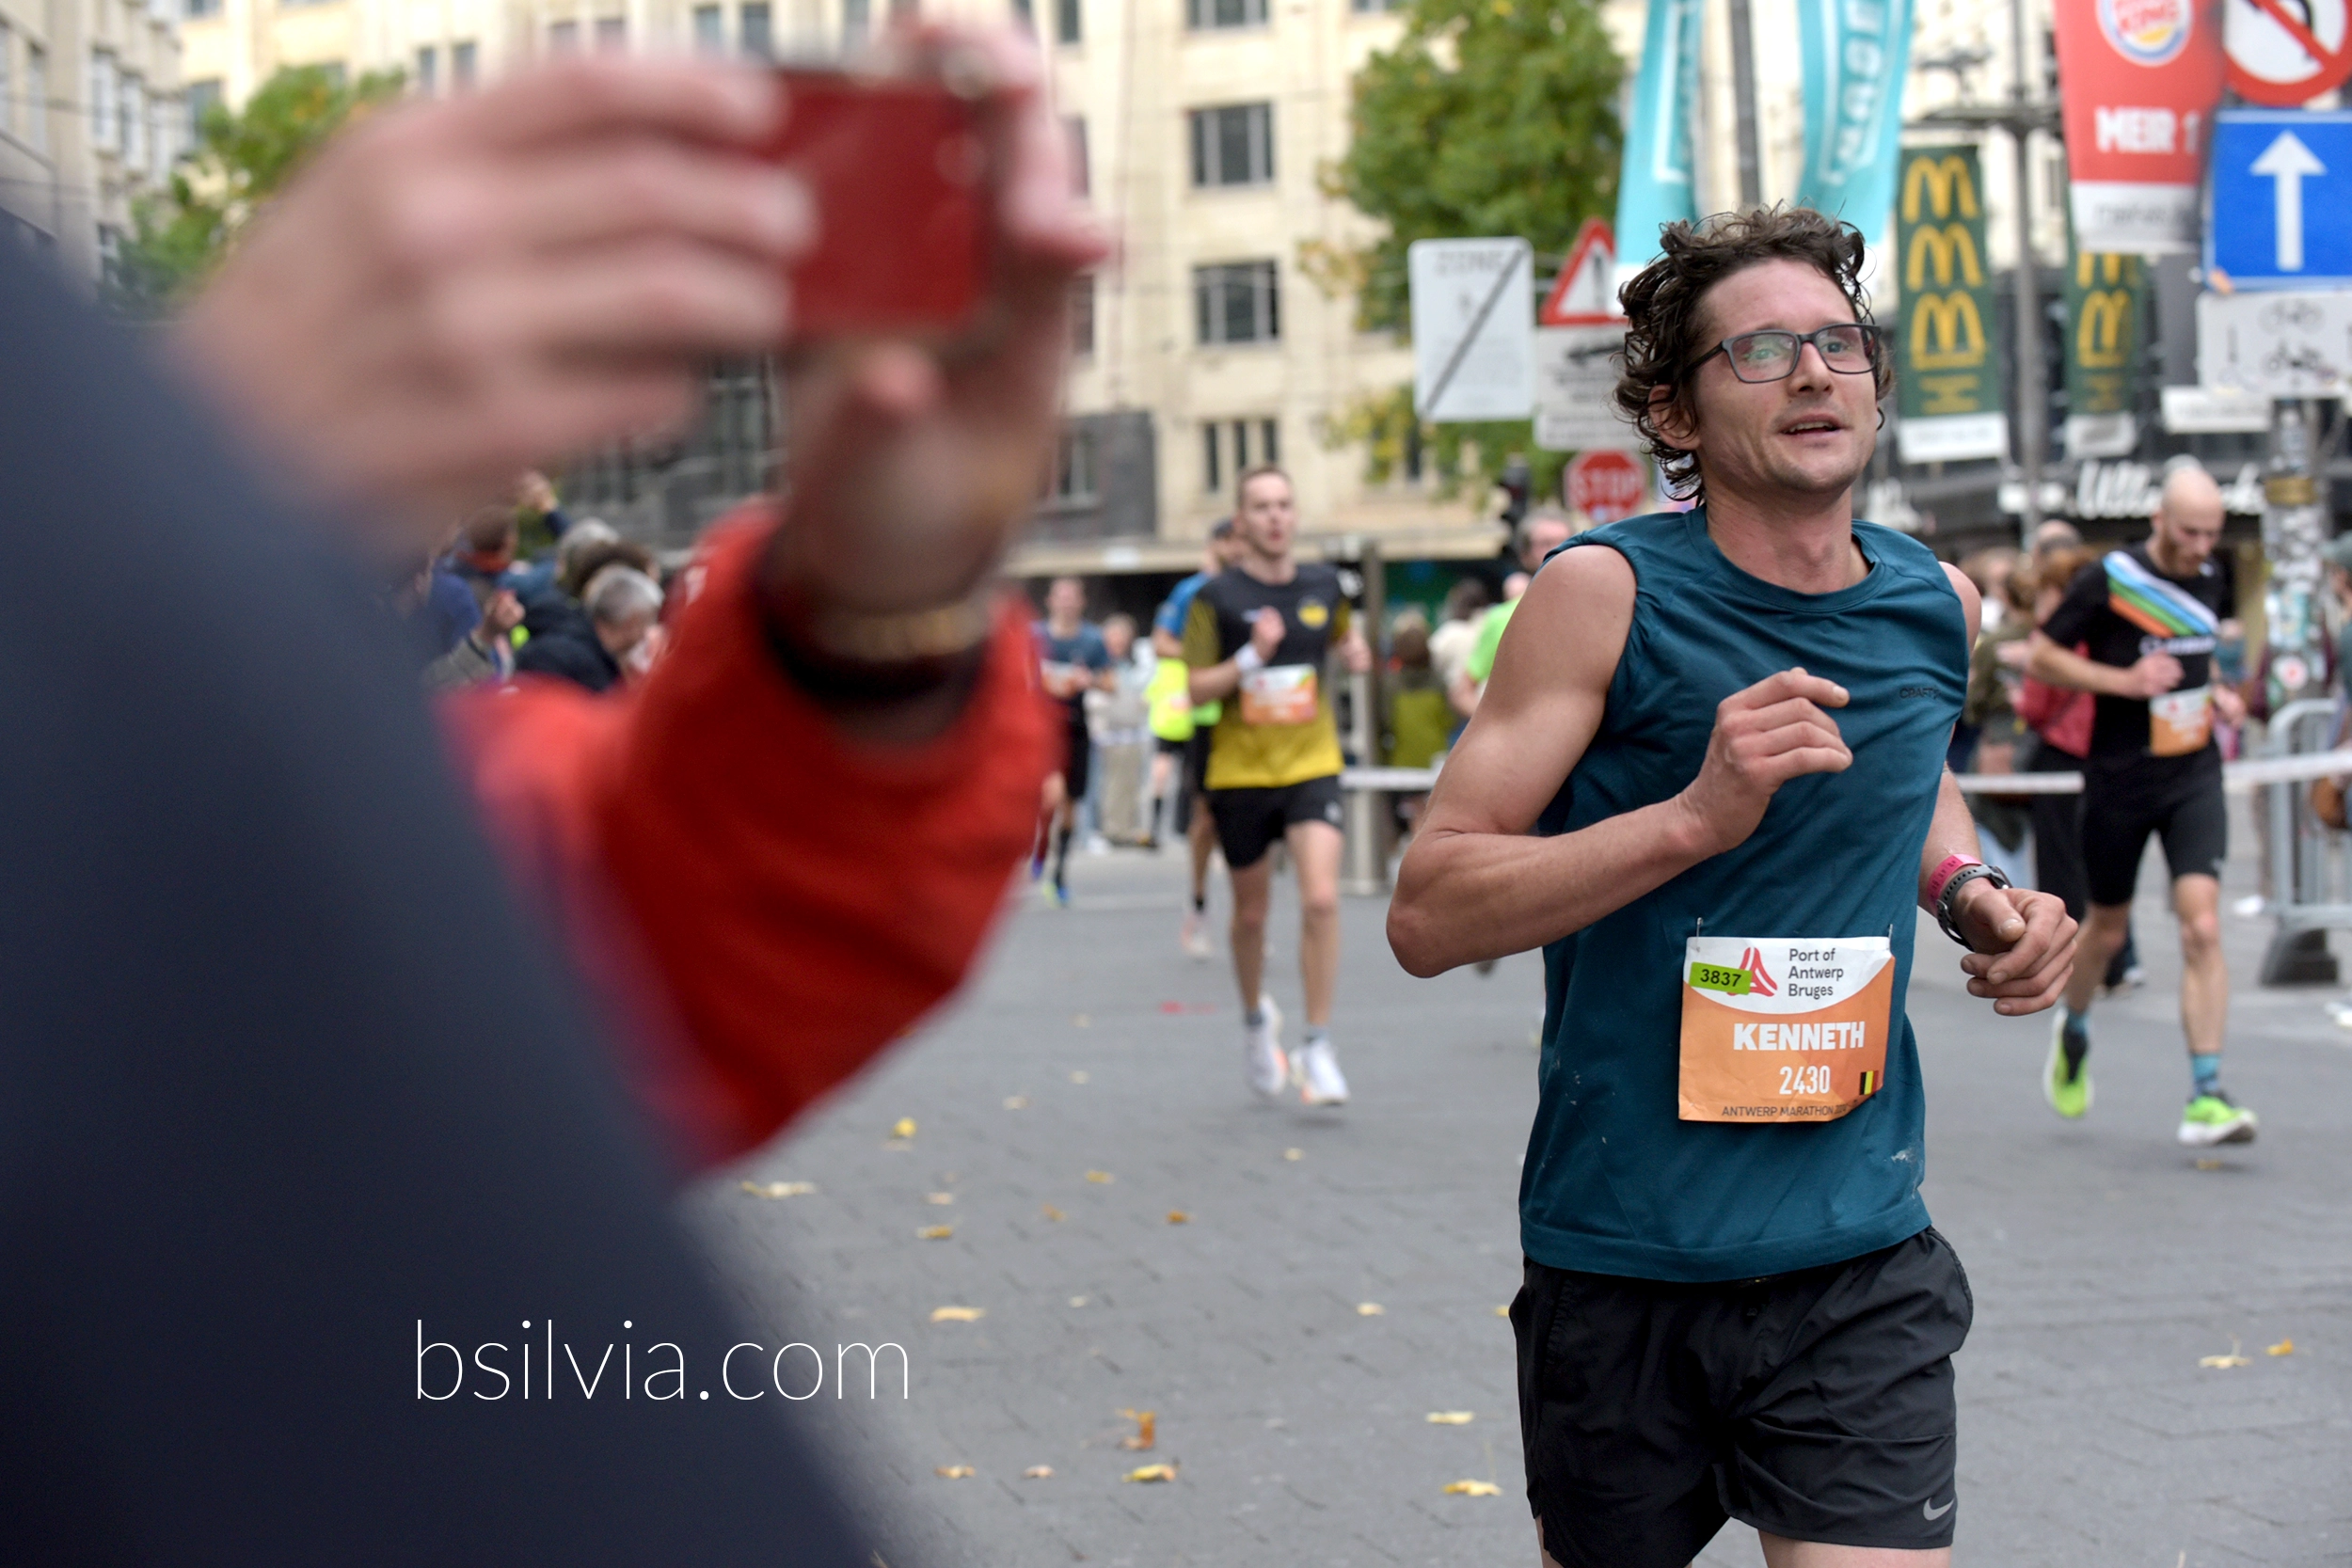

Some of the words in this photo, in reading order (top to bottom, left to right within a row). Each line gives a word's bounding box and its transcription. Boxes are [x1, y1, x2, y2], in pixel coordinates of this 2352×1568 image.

[2094, 106, 2175, 154] MEIR
[1565, 467, 1646, 502] STOP
[1789, 948, 1820, 961] Port
[1822, 948, 1836, 961] of
[1700, 969, 1741, 987] 3837
[1788, 966, 1844, 981] Antwerp
[1788, 984, 1834, 1000] Bruges
[1733, 1022, 1866, 1051] KENNETH
[1778, 1065, 1831, 1095] 2430
[1722, 1106, 1777, 1117] ANTWERP
[1779, 1104, 1834, 1117] MARATHON
